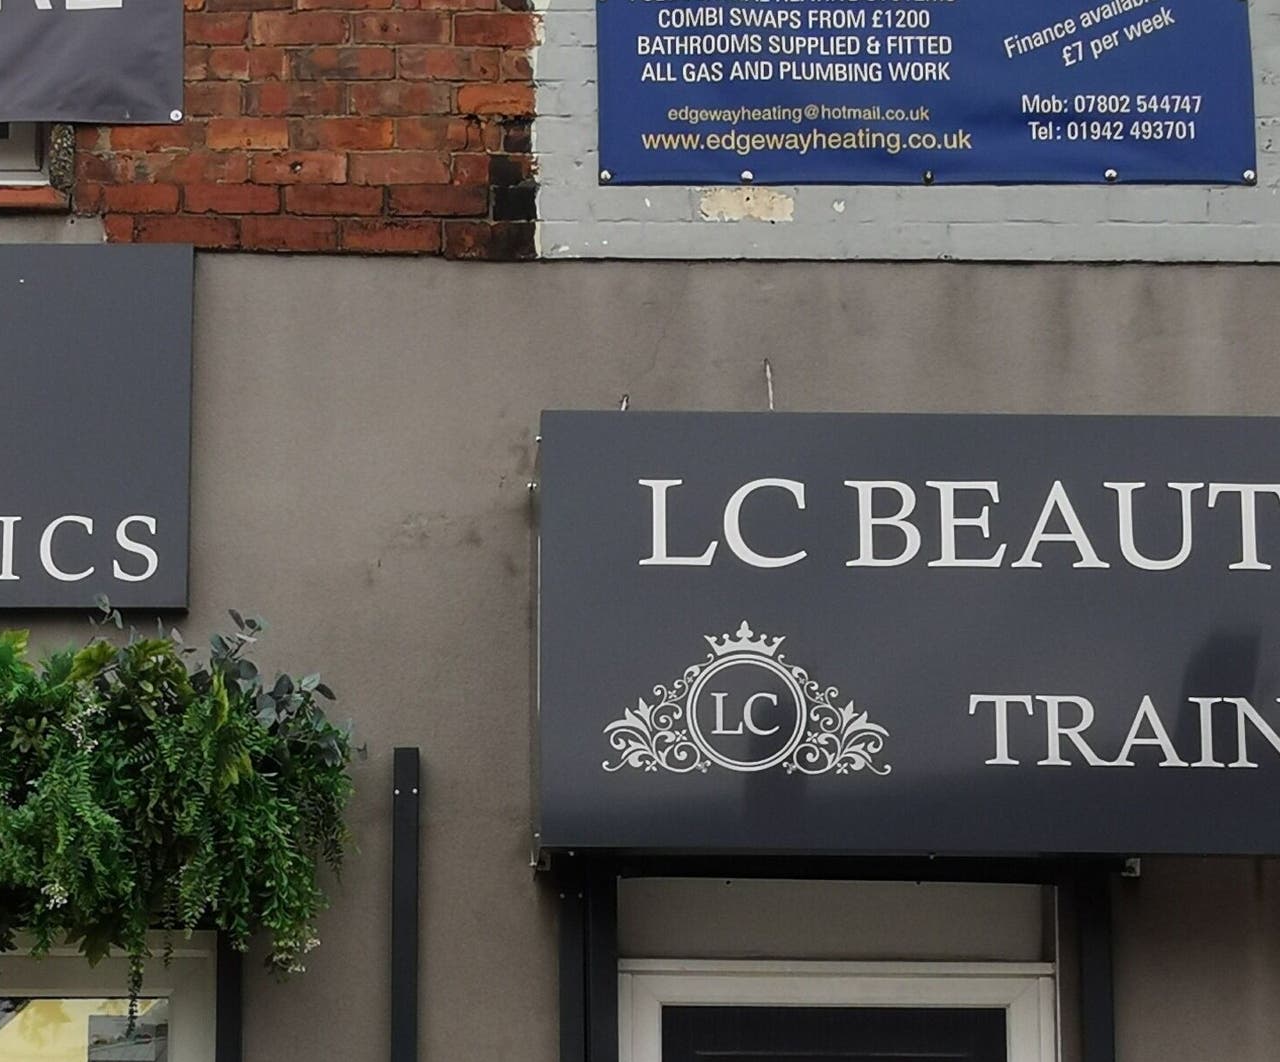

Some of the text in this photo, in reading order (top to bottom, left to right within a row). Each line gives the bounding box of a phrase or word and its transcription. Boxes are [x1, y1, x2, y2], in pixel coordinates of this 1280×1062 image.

[658, 7, 930, 29] COMBI SWAPS FROM £1200
[1003, 0, 1154, 58] Finance availab
[637, 34, 952, 56] BATHROOMS SUPPLIED & FITTED
[1062, 6, 1176, 67] £7 per week
[641, 61, 950, 82] ALL GAS AND PLUMBING WORK
[668, 104, 930, 125] edgewayheating@hotmail.co.uk
[1021, 94, 1202, 113] Mob: 07802 544747
[641, 128, 972, 154] www.edgewayheating.co.uk
[1028, 121, 1196, 140] Tel: 01942 493701
[639, 477, 808, 569] LC
[710, 692, 780, 736] LC
